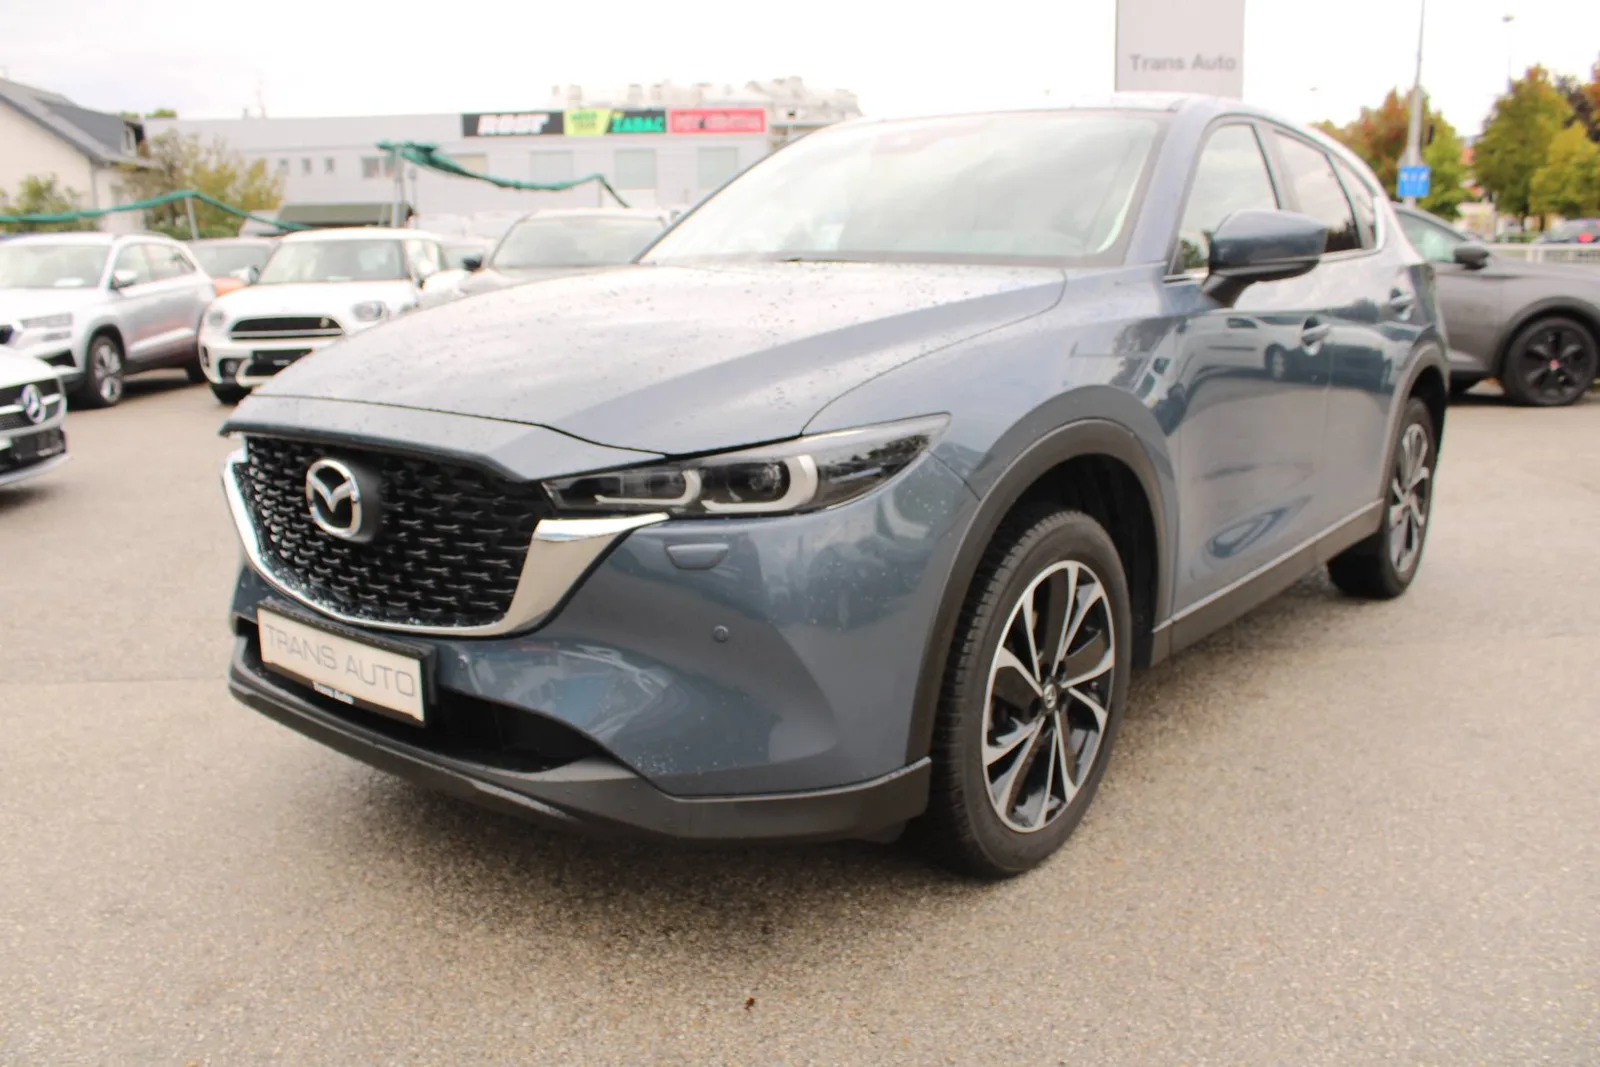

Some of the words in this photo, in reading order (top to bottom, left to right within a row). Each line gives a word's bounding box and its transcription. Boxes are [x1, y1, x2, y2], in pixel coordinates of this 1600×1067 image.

[1129, 53, 1185, 72] Trans
[1191, 52, 1237, 72] Auto
[264, 622, 338, 671] TRANS
[344, 654, 416, 698] AUTO
